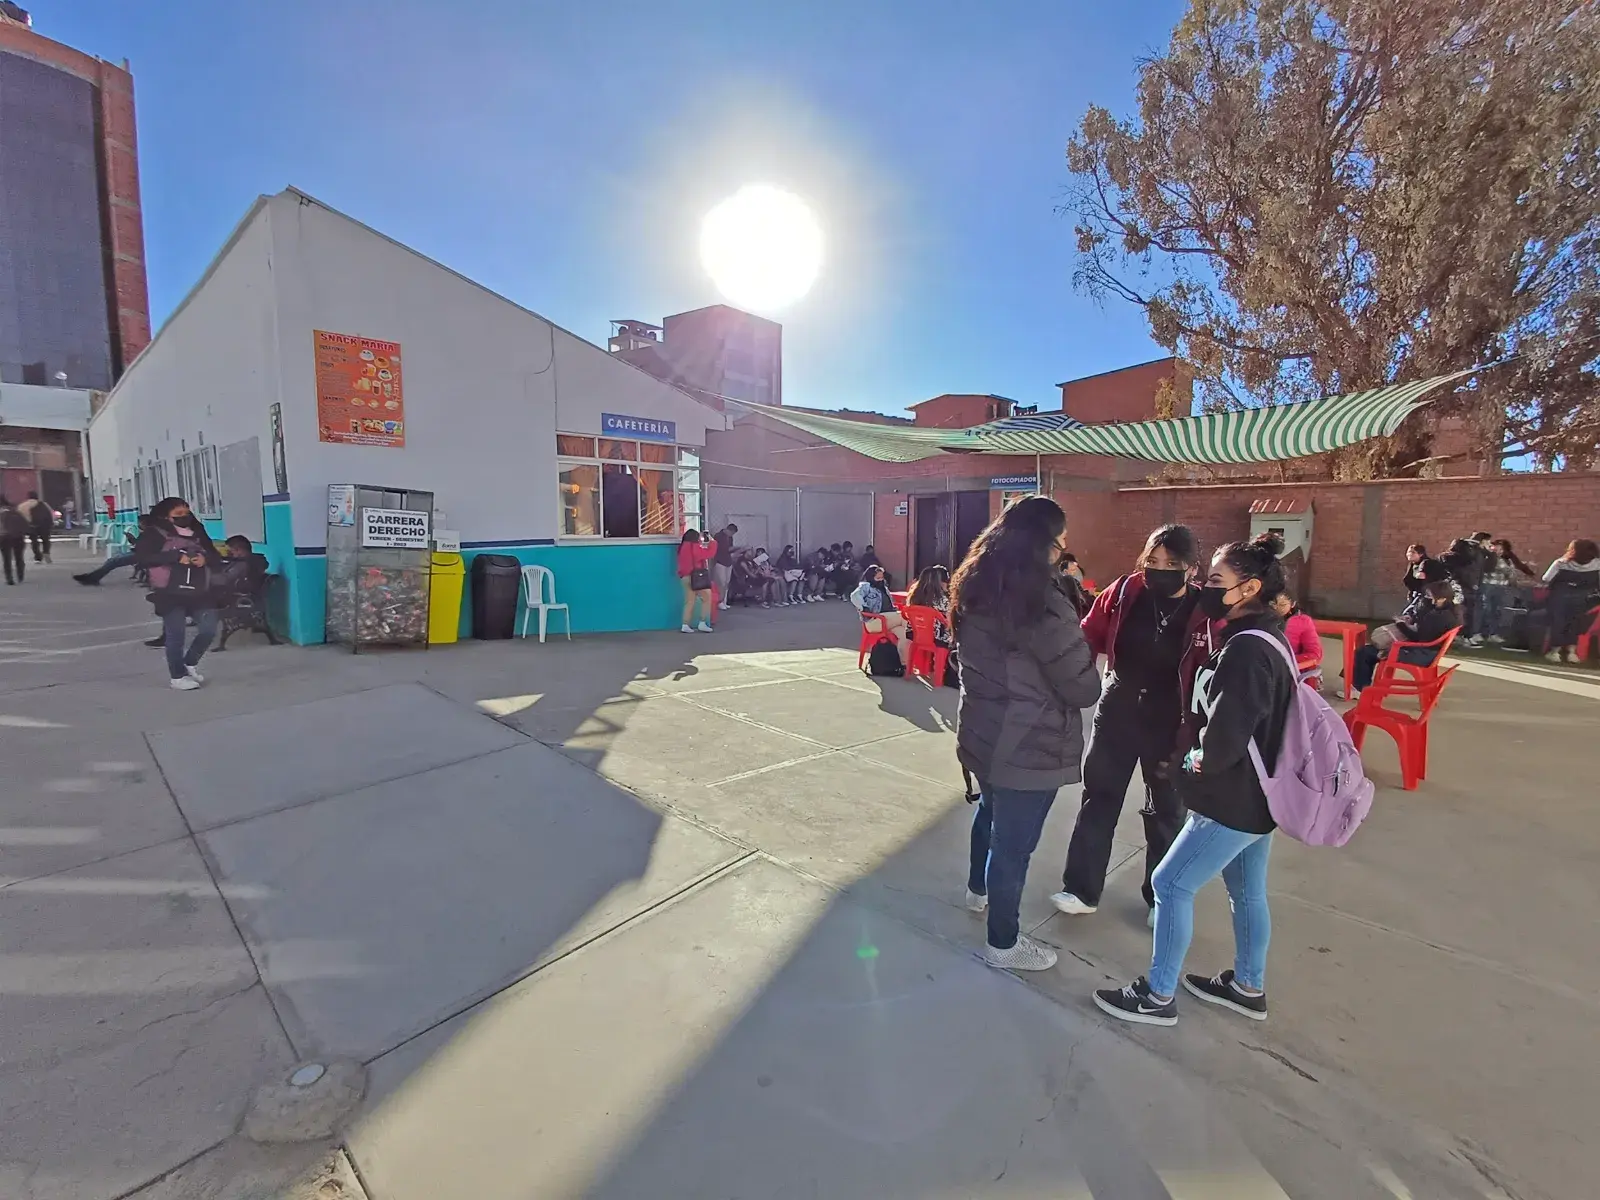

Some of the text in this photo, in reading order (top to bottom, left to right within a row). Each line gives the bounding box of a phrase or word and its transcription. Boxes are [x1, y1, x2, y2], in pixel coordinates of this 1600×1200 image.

[320, 333, 394, 351] SNACK MARIA
[607, 418, 670, 434] CAFETERÍA
[991, 476, 1038, 484] FOTOCOPIADOR
[367, 515, 424, 526] CARRERA
[369, 526, 426, 536] DERECHO
